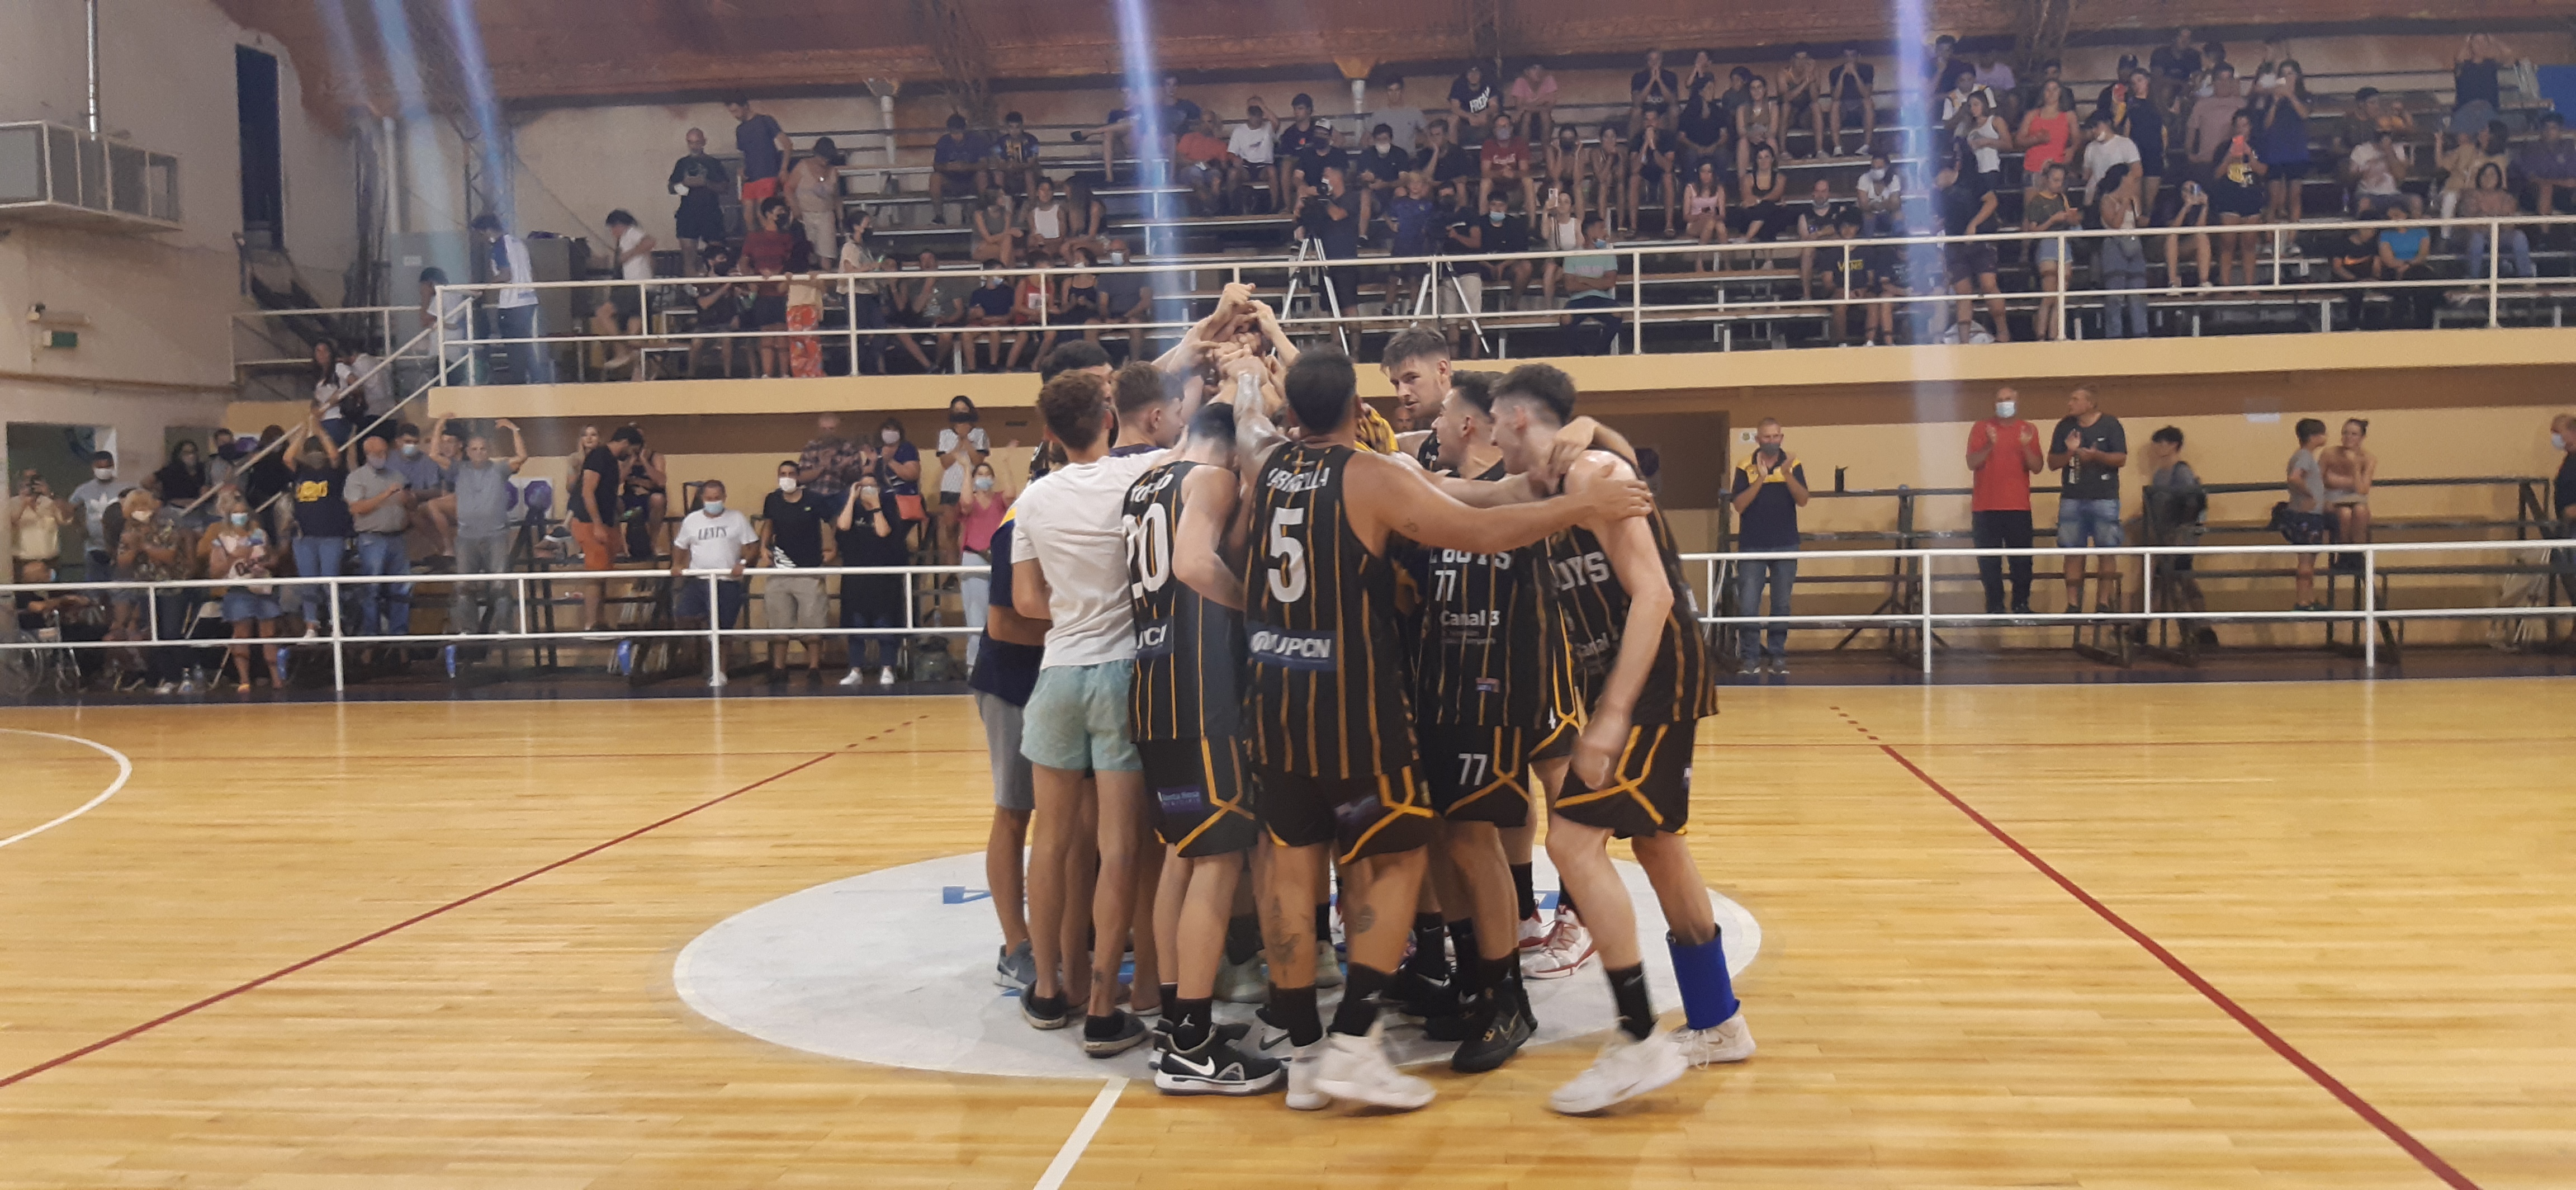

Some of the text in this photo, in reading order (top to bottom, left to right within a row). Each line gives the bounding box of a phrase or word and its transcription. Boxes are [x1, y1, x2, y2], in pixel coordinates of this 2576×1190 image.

[1837, 259, 1863, 272] VNS
[1268, 507, 1307, 603] 5
[1434, 570, 1457, 602] 77
[1439, 610, 1500, 626] Canal 3
[1458, 753, 1488, 786] 77
